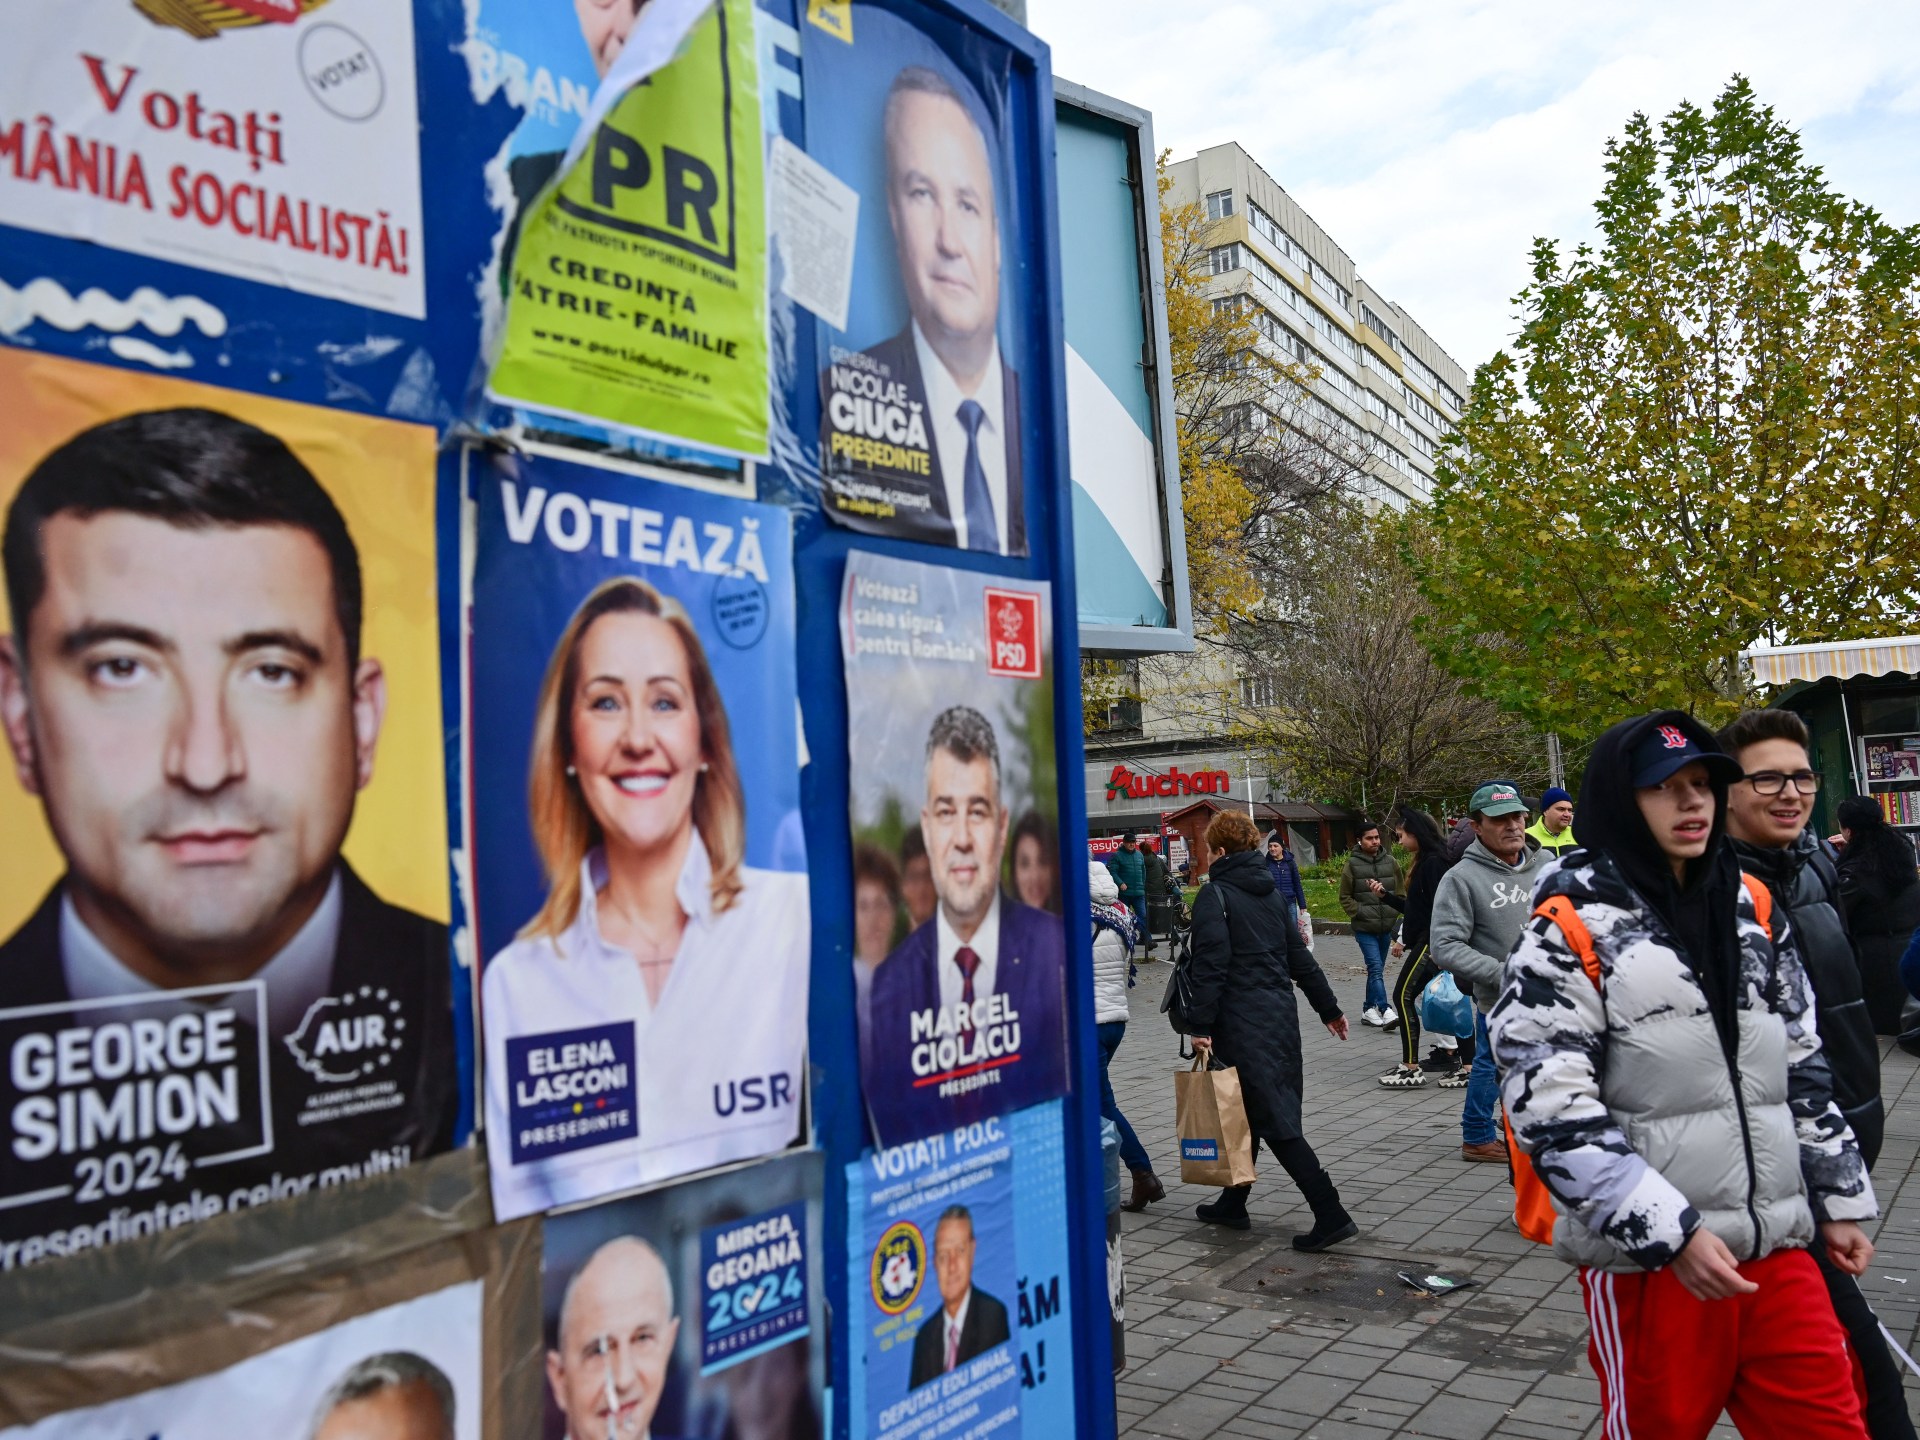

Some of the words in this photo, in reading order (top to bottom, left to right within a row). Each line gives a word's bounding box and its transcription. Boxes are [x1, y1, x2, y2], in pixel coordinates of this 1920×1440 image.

[311, 52, 370, 92] VOTAT
[79, 52, 286, 173] Votați
[168, 164, 409, 275] SOCIALISTĂ!
[548, 254, 697, 314] CREDINȚĂ
[831, 364, 908, 408] NICOLAE
[829, 391, 929, 450] CIUCĂ
[831, 431, 931, 476] PREȘEDINTE
[501, 480, 769, 583] VOTEAZĂ
[856, 577, 918, 604] Votează
[855, 608, 896, 628] calea
[899, 611, 944, 636] sigură
[996, 641, 1027, 668] PSD
[1106, 765, 1230, 800] Auchan
[314, 1014, 387, 1057] AUR
[910, 992, 1019, 1043] MARCEL
[12, 1009, 237, 1092] GEORGE
[527, 1038, 616, 1076] ELENA
[911, 1022, 1021, 1077] CIOLACU
[516, 1063, 629, 1107] LASCONI
[714, 1072, 792, 1117] USR
[12, 1066, 239, 1161] SIMION
[520, 1109, 630, 1148] PREȘEDINTE
[75, 1141, 189, 1203] 2024
[872, 1133, 946, 1181] VOTAȚI
[954, 1116, 1005, 1154] P.O.C.
[716, 1214, 793, 1257] MIRCEA
[707, 1230, 802, 1290] GEOANĂ
[707, 1265, 803, 1332] 2024
